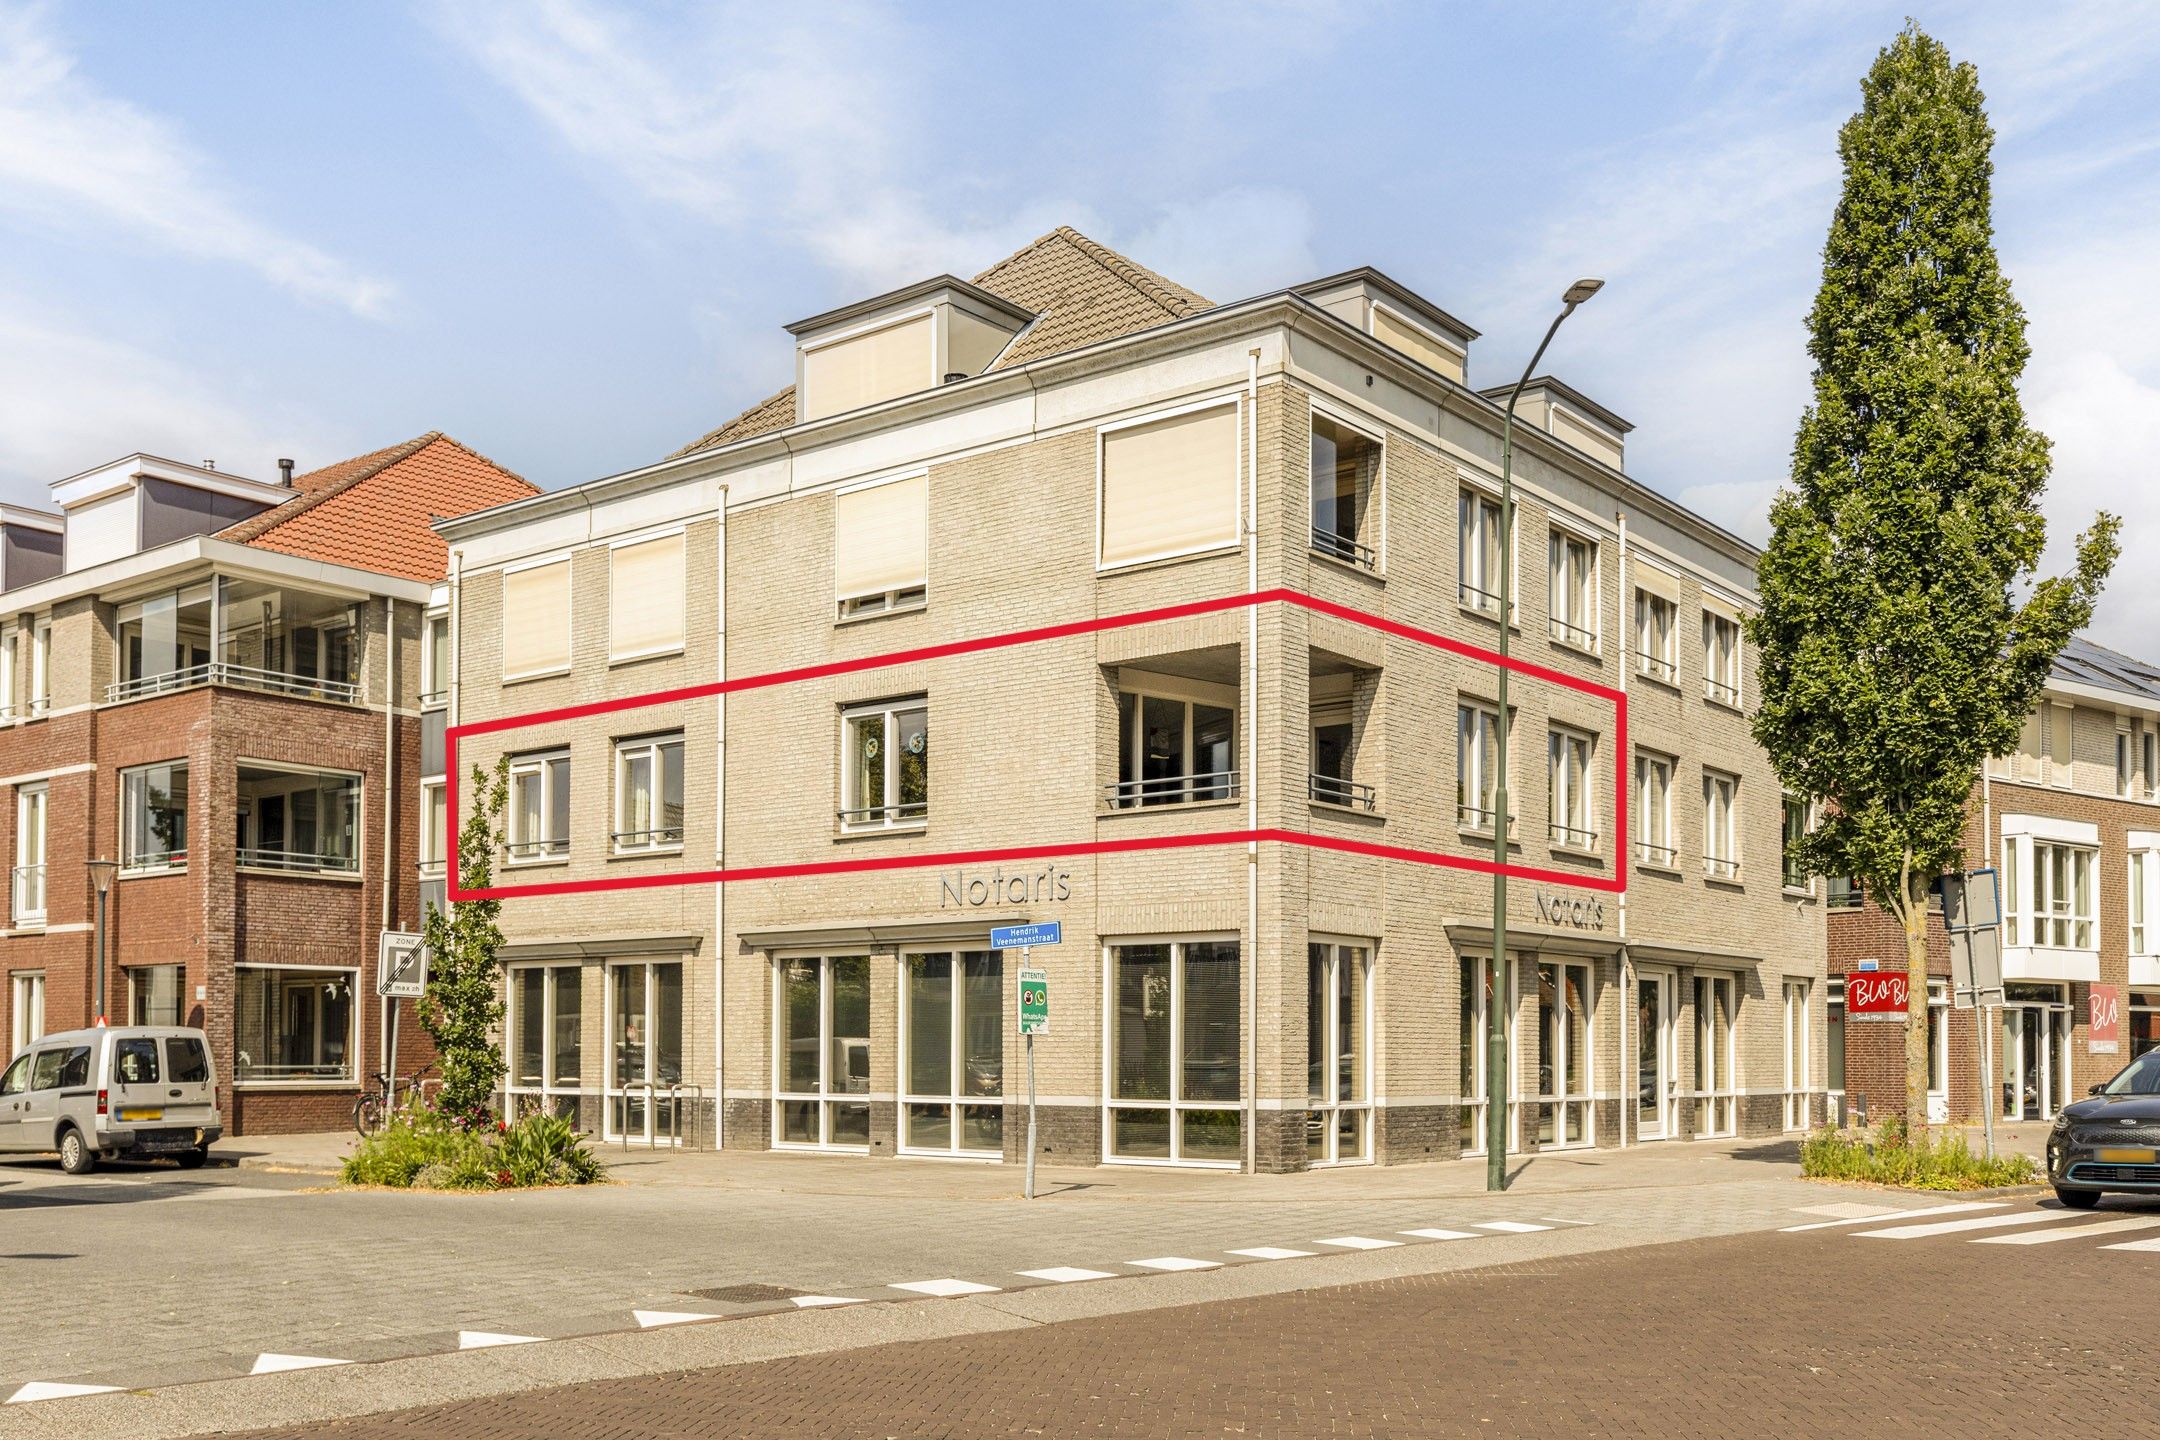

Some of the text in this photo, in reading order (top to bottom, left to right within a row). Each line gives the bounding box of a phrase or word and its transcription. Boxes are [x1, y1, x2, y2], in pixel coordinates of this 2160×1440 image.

[940, 863, 1071, 908] Notaris
[1534, 887, 1603, 931] Notaris
[996, 933, 1054, 946] Veenemanstraat
[1010, 926, 1039, 936] Hendrik
